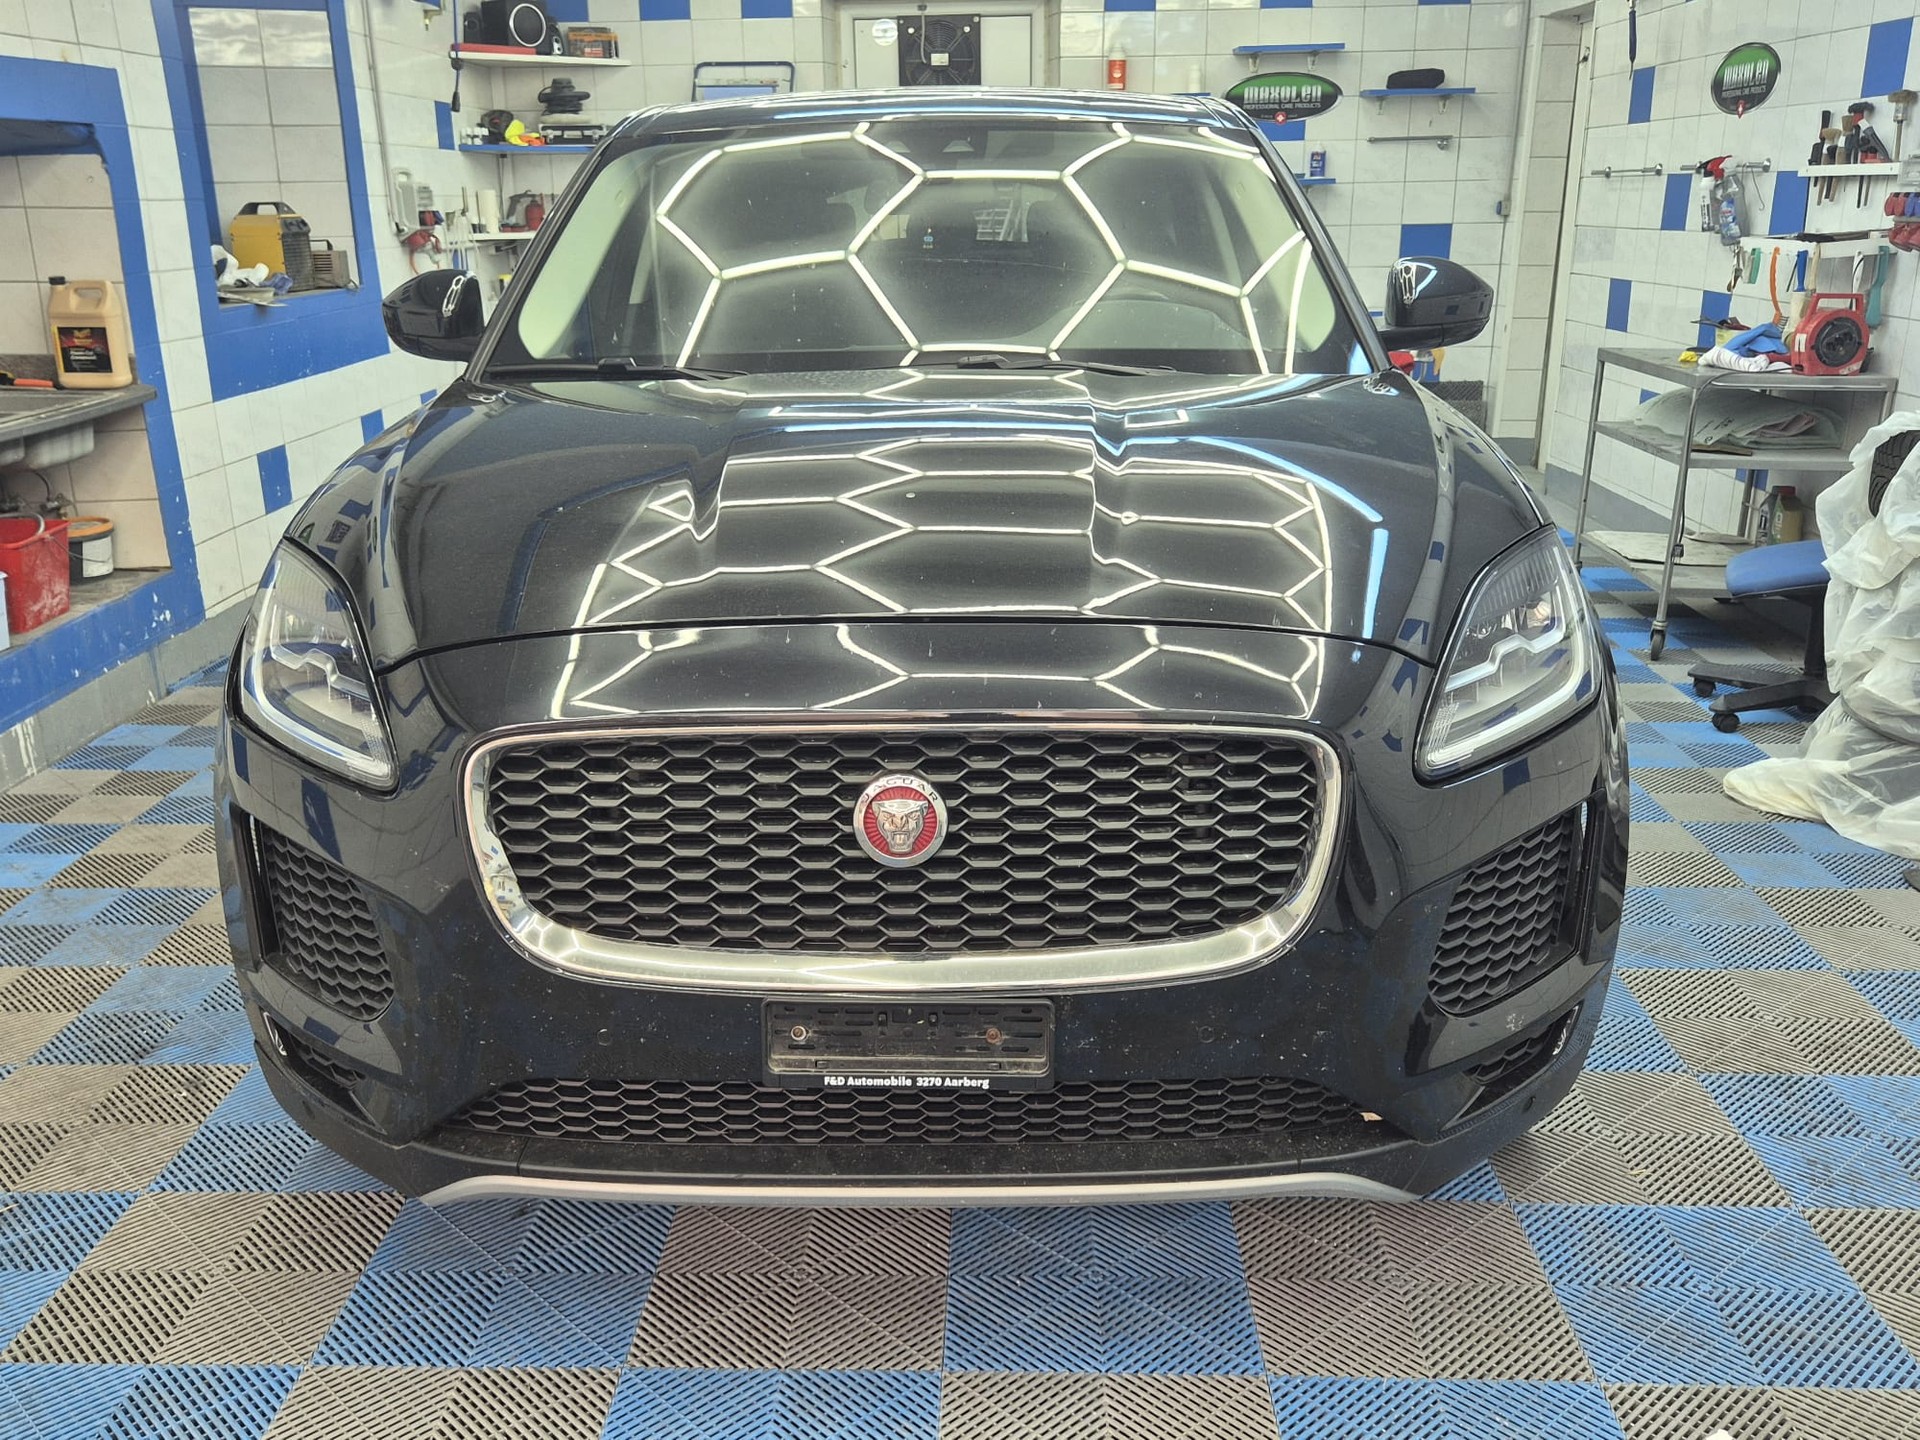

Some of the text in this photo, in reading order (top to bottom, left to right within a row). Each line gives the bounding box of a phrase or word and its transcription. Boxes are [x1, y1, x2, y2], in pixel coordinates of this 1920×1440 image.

[861, 777, 938, 803] JAGUAR
[824, 1075, 990, 1090] F&D Automobile 3270 Aarberg
